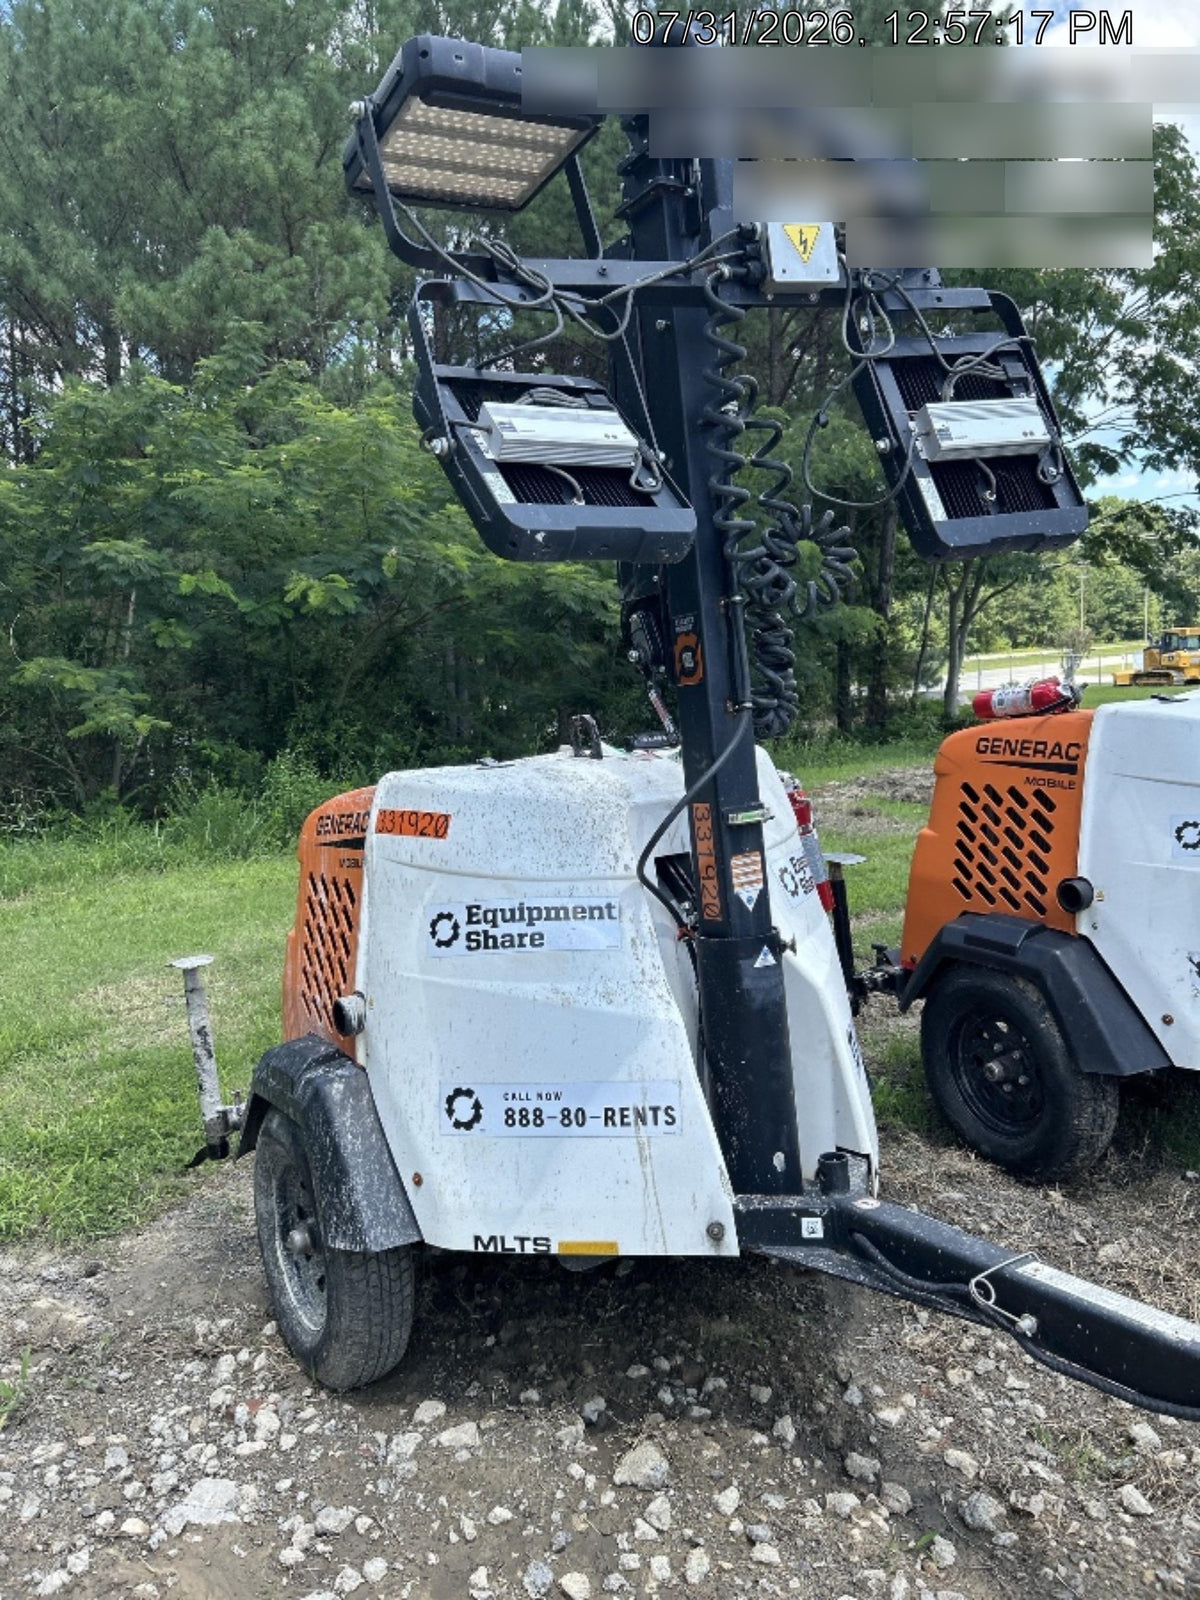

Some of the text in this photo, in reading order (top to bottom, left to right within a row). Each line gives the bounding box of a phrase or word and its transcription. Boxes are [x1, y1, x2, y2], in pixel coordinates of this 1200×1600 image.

[976, 737, 1081, 761] GENERAC
[1024, 776, 1076, 790] MOBILE
[377, 809, 450, 839] 331920
[694, 806, 720, 919] 331920
[465, 902, 617, 928] Equipment
[465, 930, 545, 951] Share
[503, 1091, 563, 1101] CALL NOW
[504, 1106, 677, 1128] 888-80-RENTS
[473, 1235, 552, 1253] MLTS
